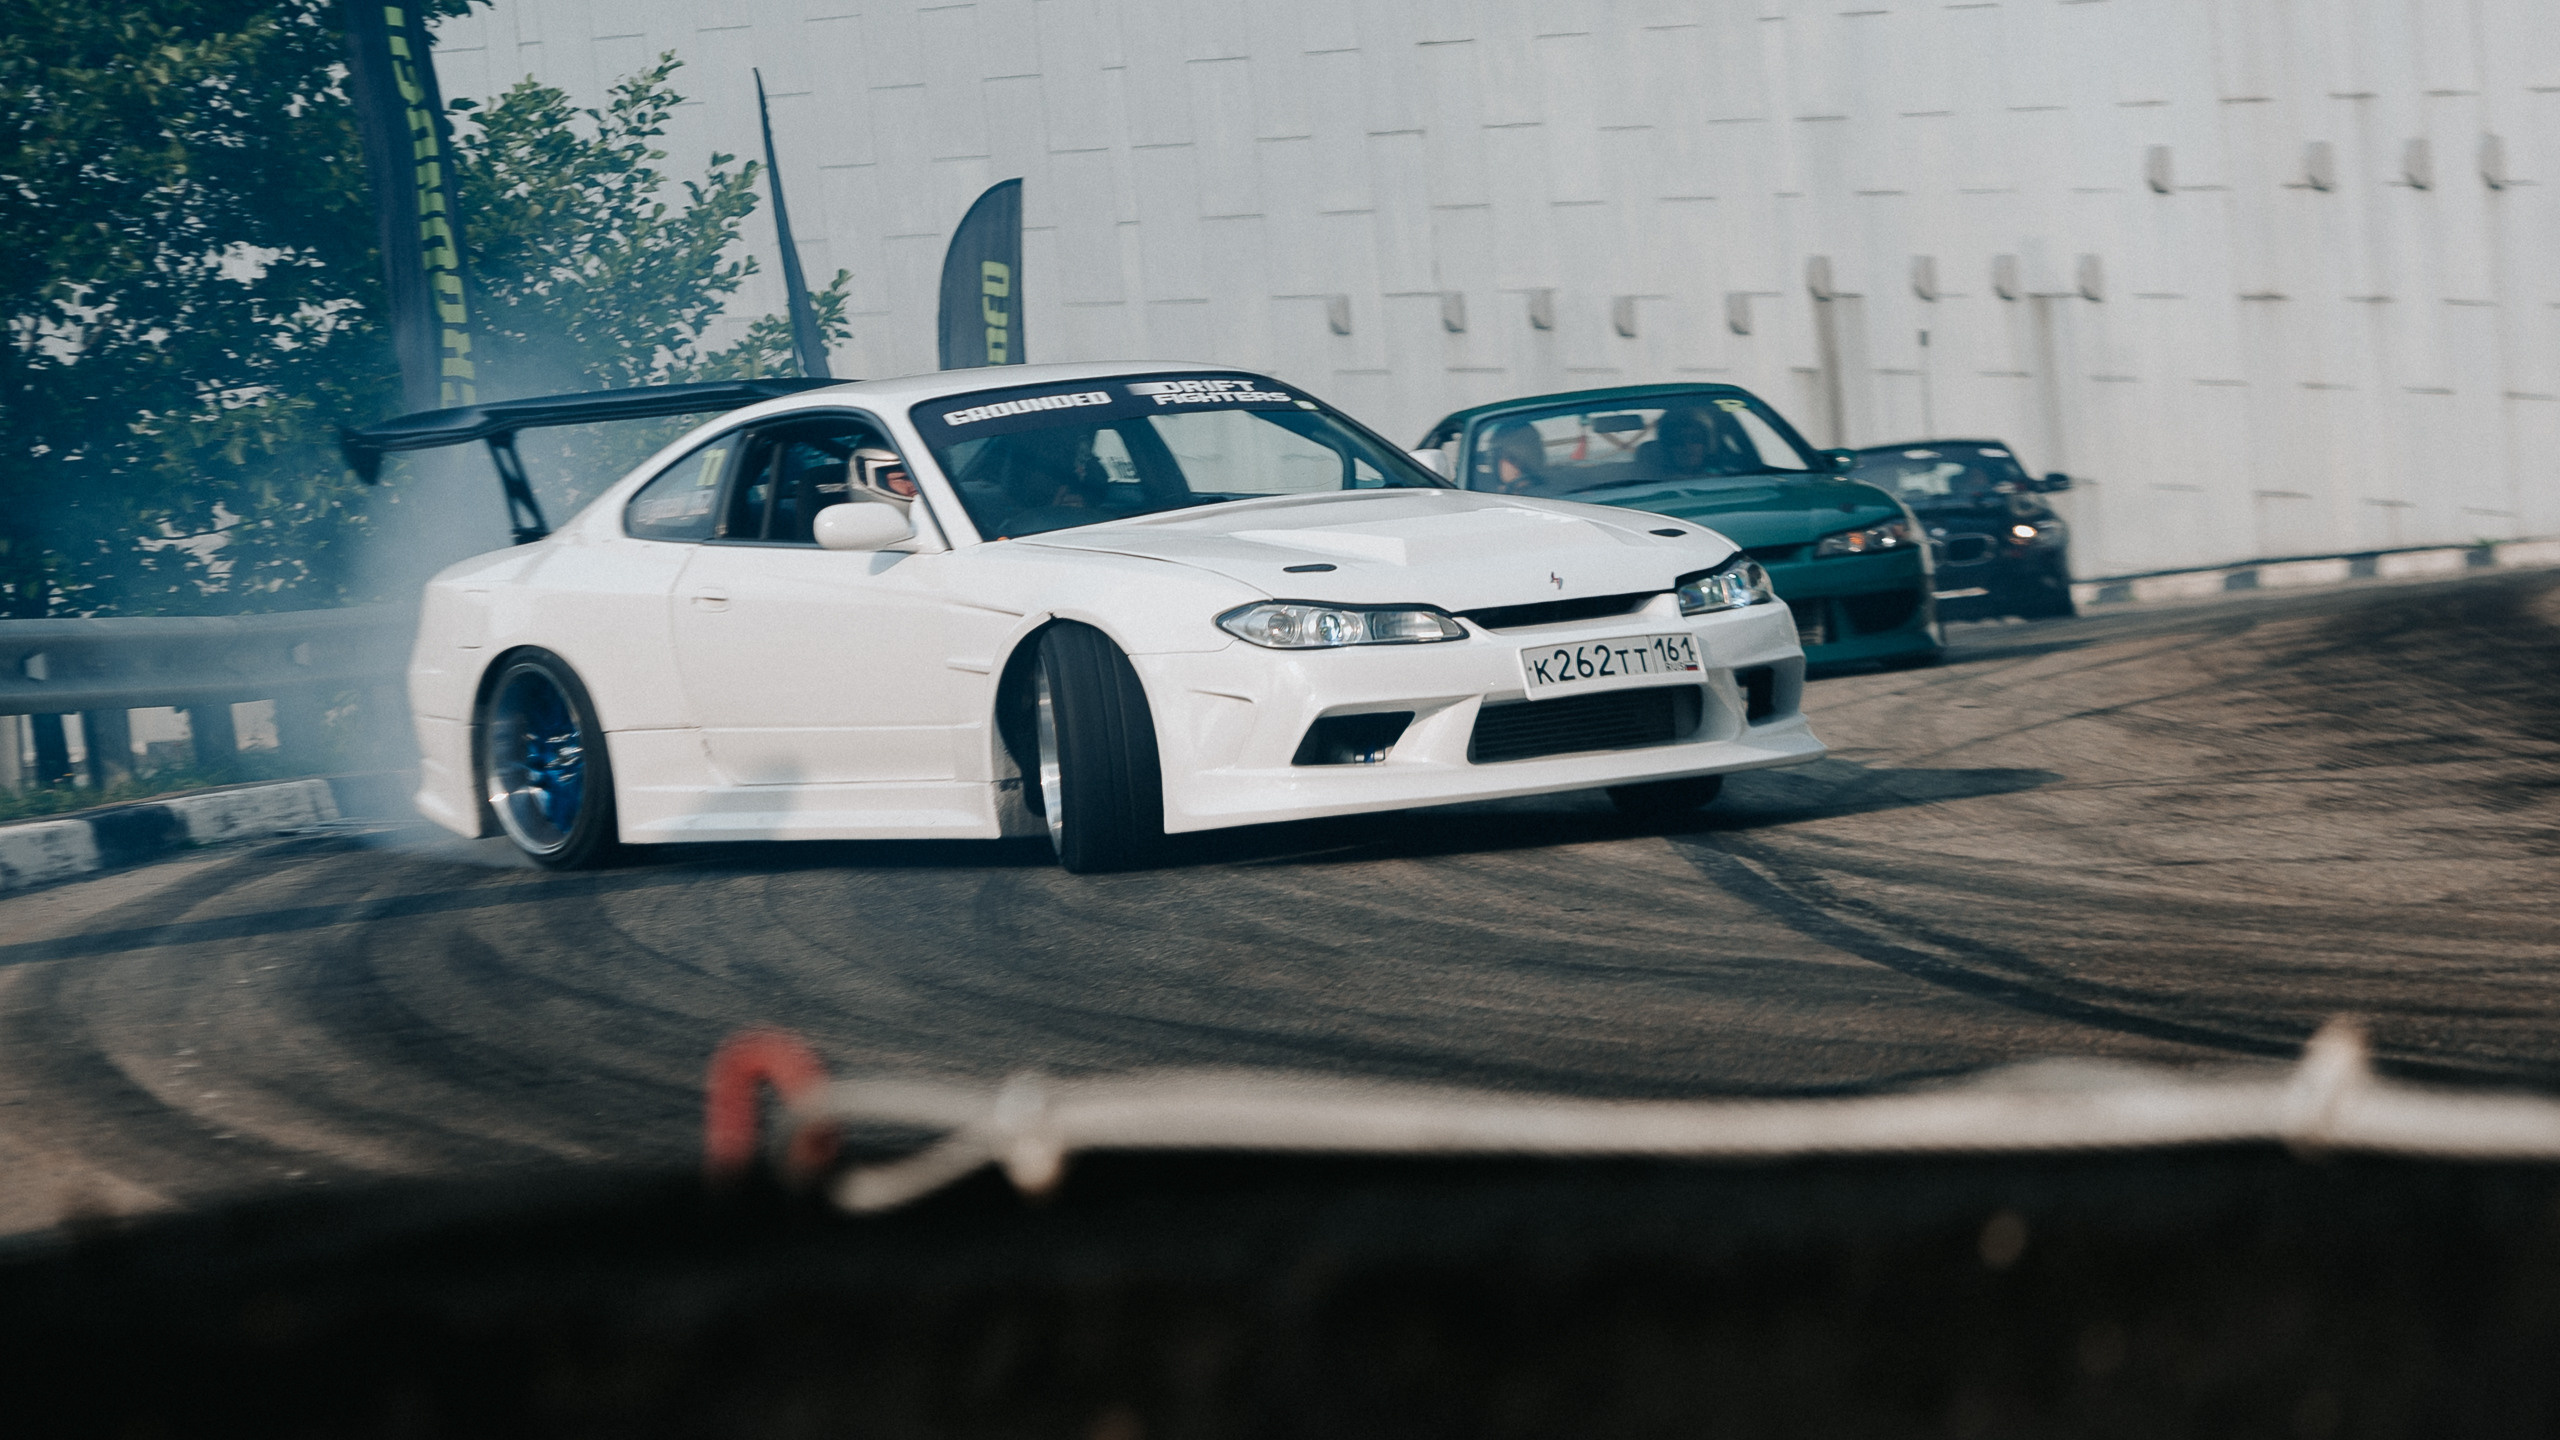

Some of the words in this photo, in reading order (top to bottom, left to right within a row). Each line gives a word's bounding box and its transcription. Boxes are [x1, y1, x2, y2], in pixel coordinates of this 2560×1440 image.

[1157, 380, 1254, 394] DRIFT
[943, 391, 1112, 425] GROUNDED
[1152, 392, 1292, 406] FIGHTERS
[1654, 637, 1694, 661] 161
